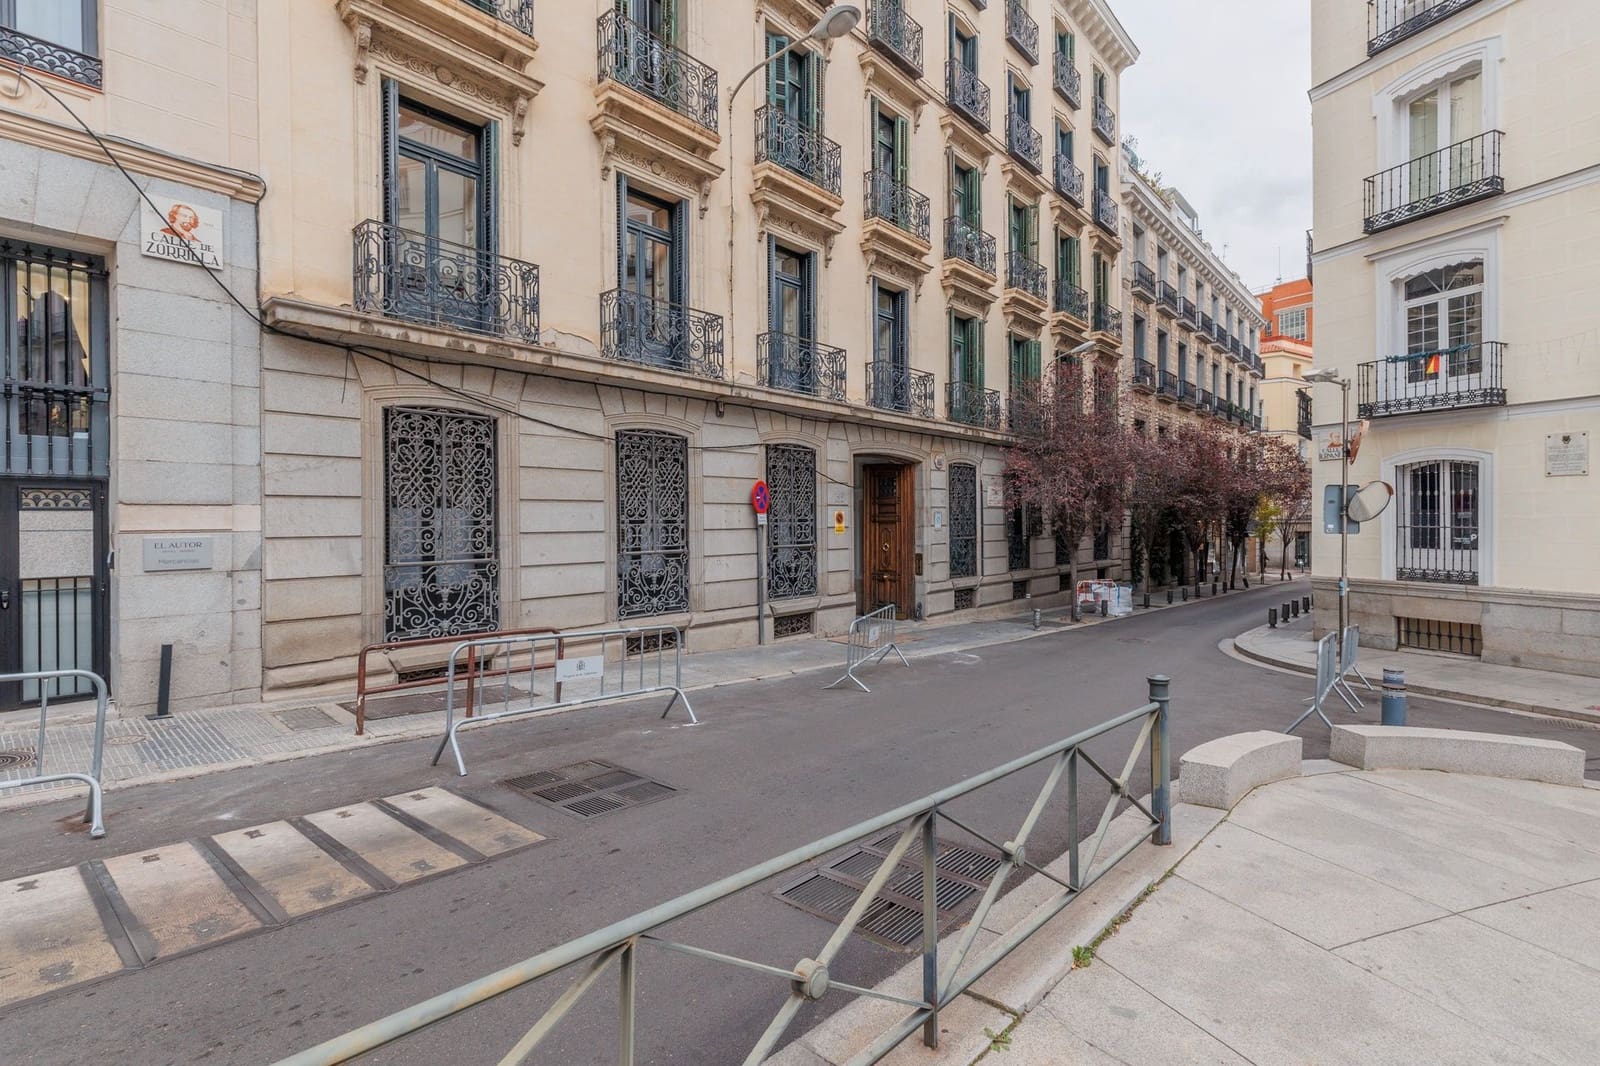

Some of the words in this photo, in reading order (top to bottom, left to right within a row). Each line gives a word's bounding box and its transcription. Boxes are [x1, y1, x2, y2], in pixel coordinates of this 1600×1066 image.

[151, 231, 197, 250] CALLE
[200, 243, 215, 253] DE
[146, 241, 219, 266] ZORRILLA
[168, 541, 203, 549] AUTOR
